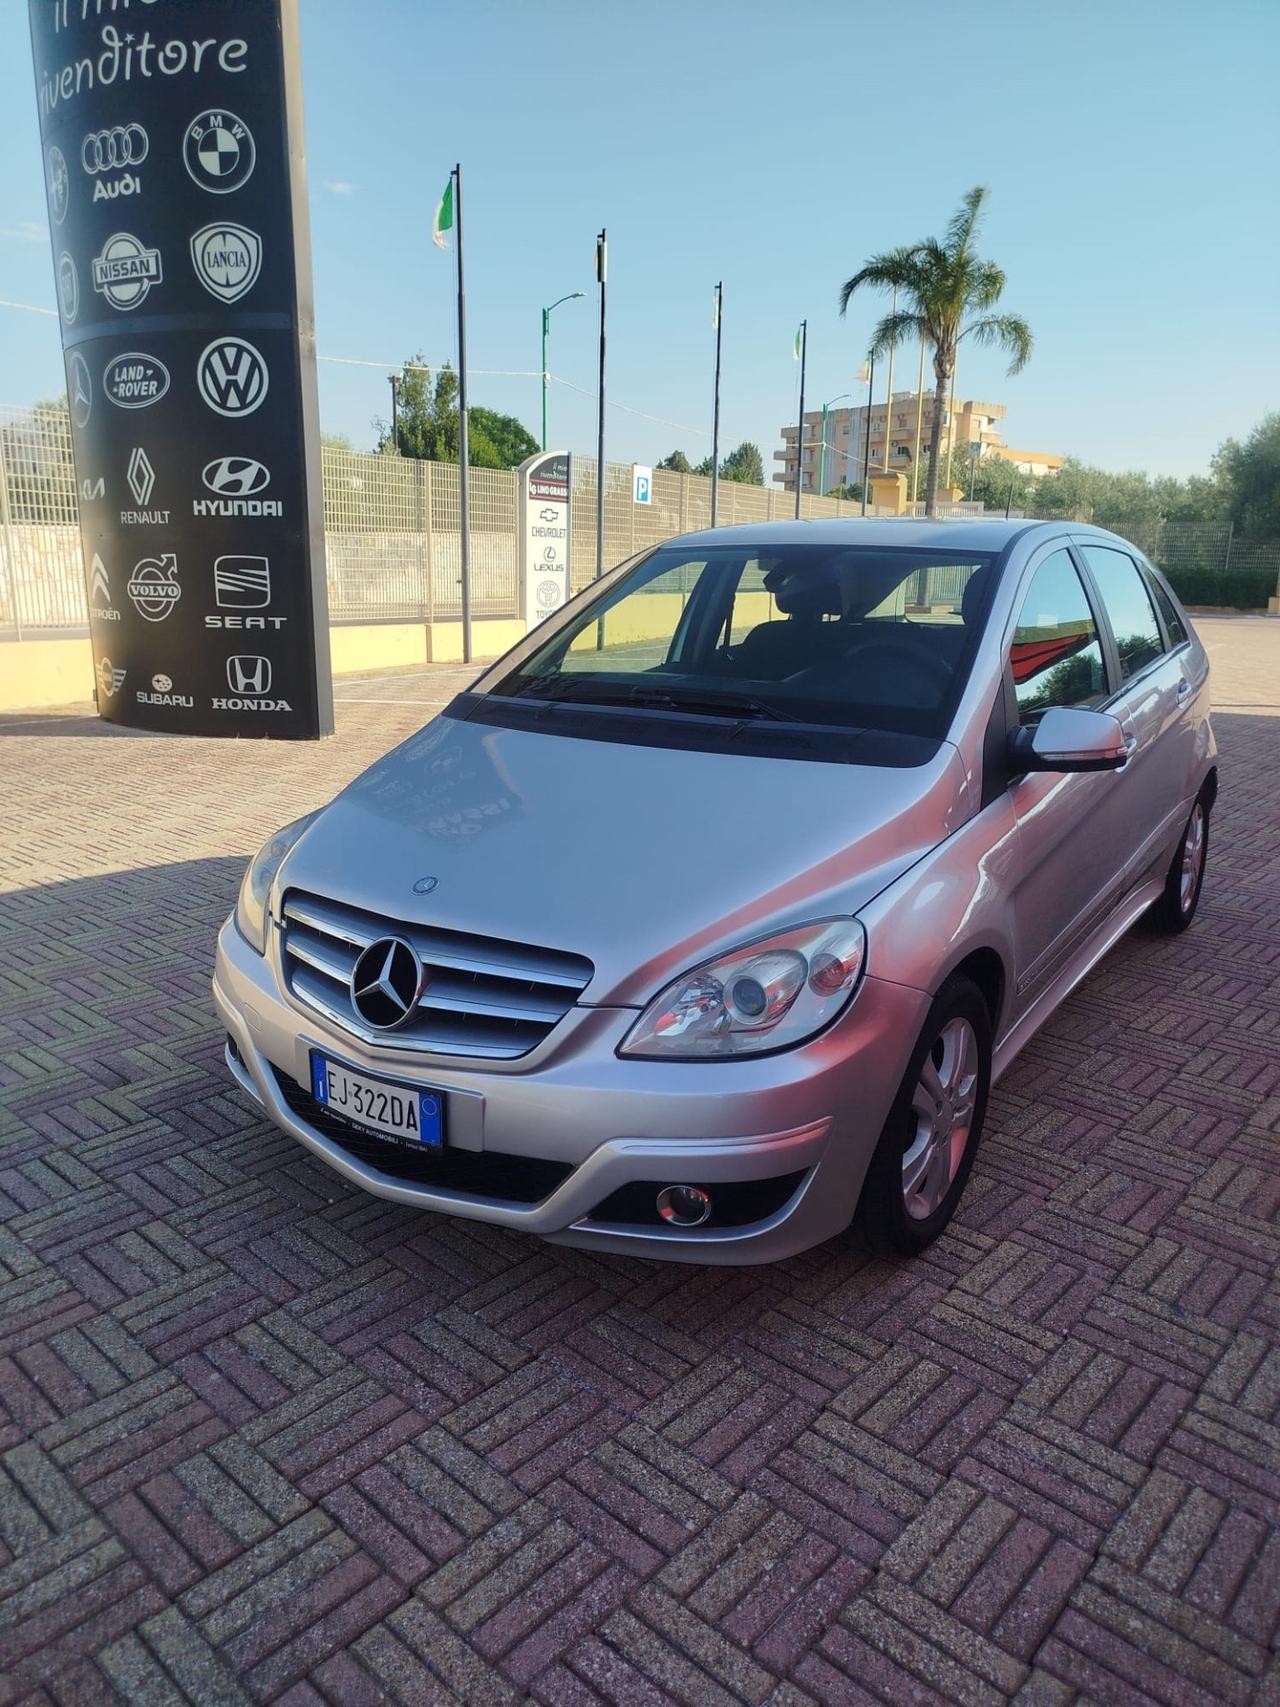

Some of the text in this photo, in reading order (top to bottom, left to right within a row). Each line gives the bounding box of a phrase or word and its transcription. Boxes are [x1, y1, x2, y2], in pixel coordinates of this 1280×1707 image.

[40, 25, 248, 114] rivenditore
[190, 115, 246, 141] BMW
[93, 173, 141, 202] Audi
[207, 250, 247, 269] LANCIA
[100, 258, 150, 281] NISSAN
[115, 365, 144, 383] LAND
[118, 381, 158, 398] ROVER
[193, 500, 283, 517] HYUNDAI
[121, 511, 170, 524] RENAULT
[532, 526, 566, 538] CHEVROLET
[534, 563, 564, 572] LEXUS
[131, 584, 178, 597] VOLVO
[205, 616, 287, 630] SEAT
[136, 692, 193, 707] SUBARU
[212, 698, 293, 712] HONDA
[327, 1070, 418, 1131] EJ322DA
